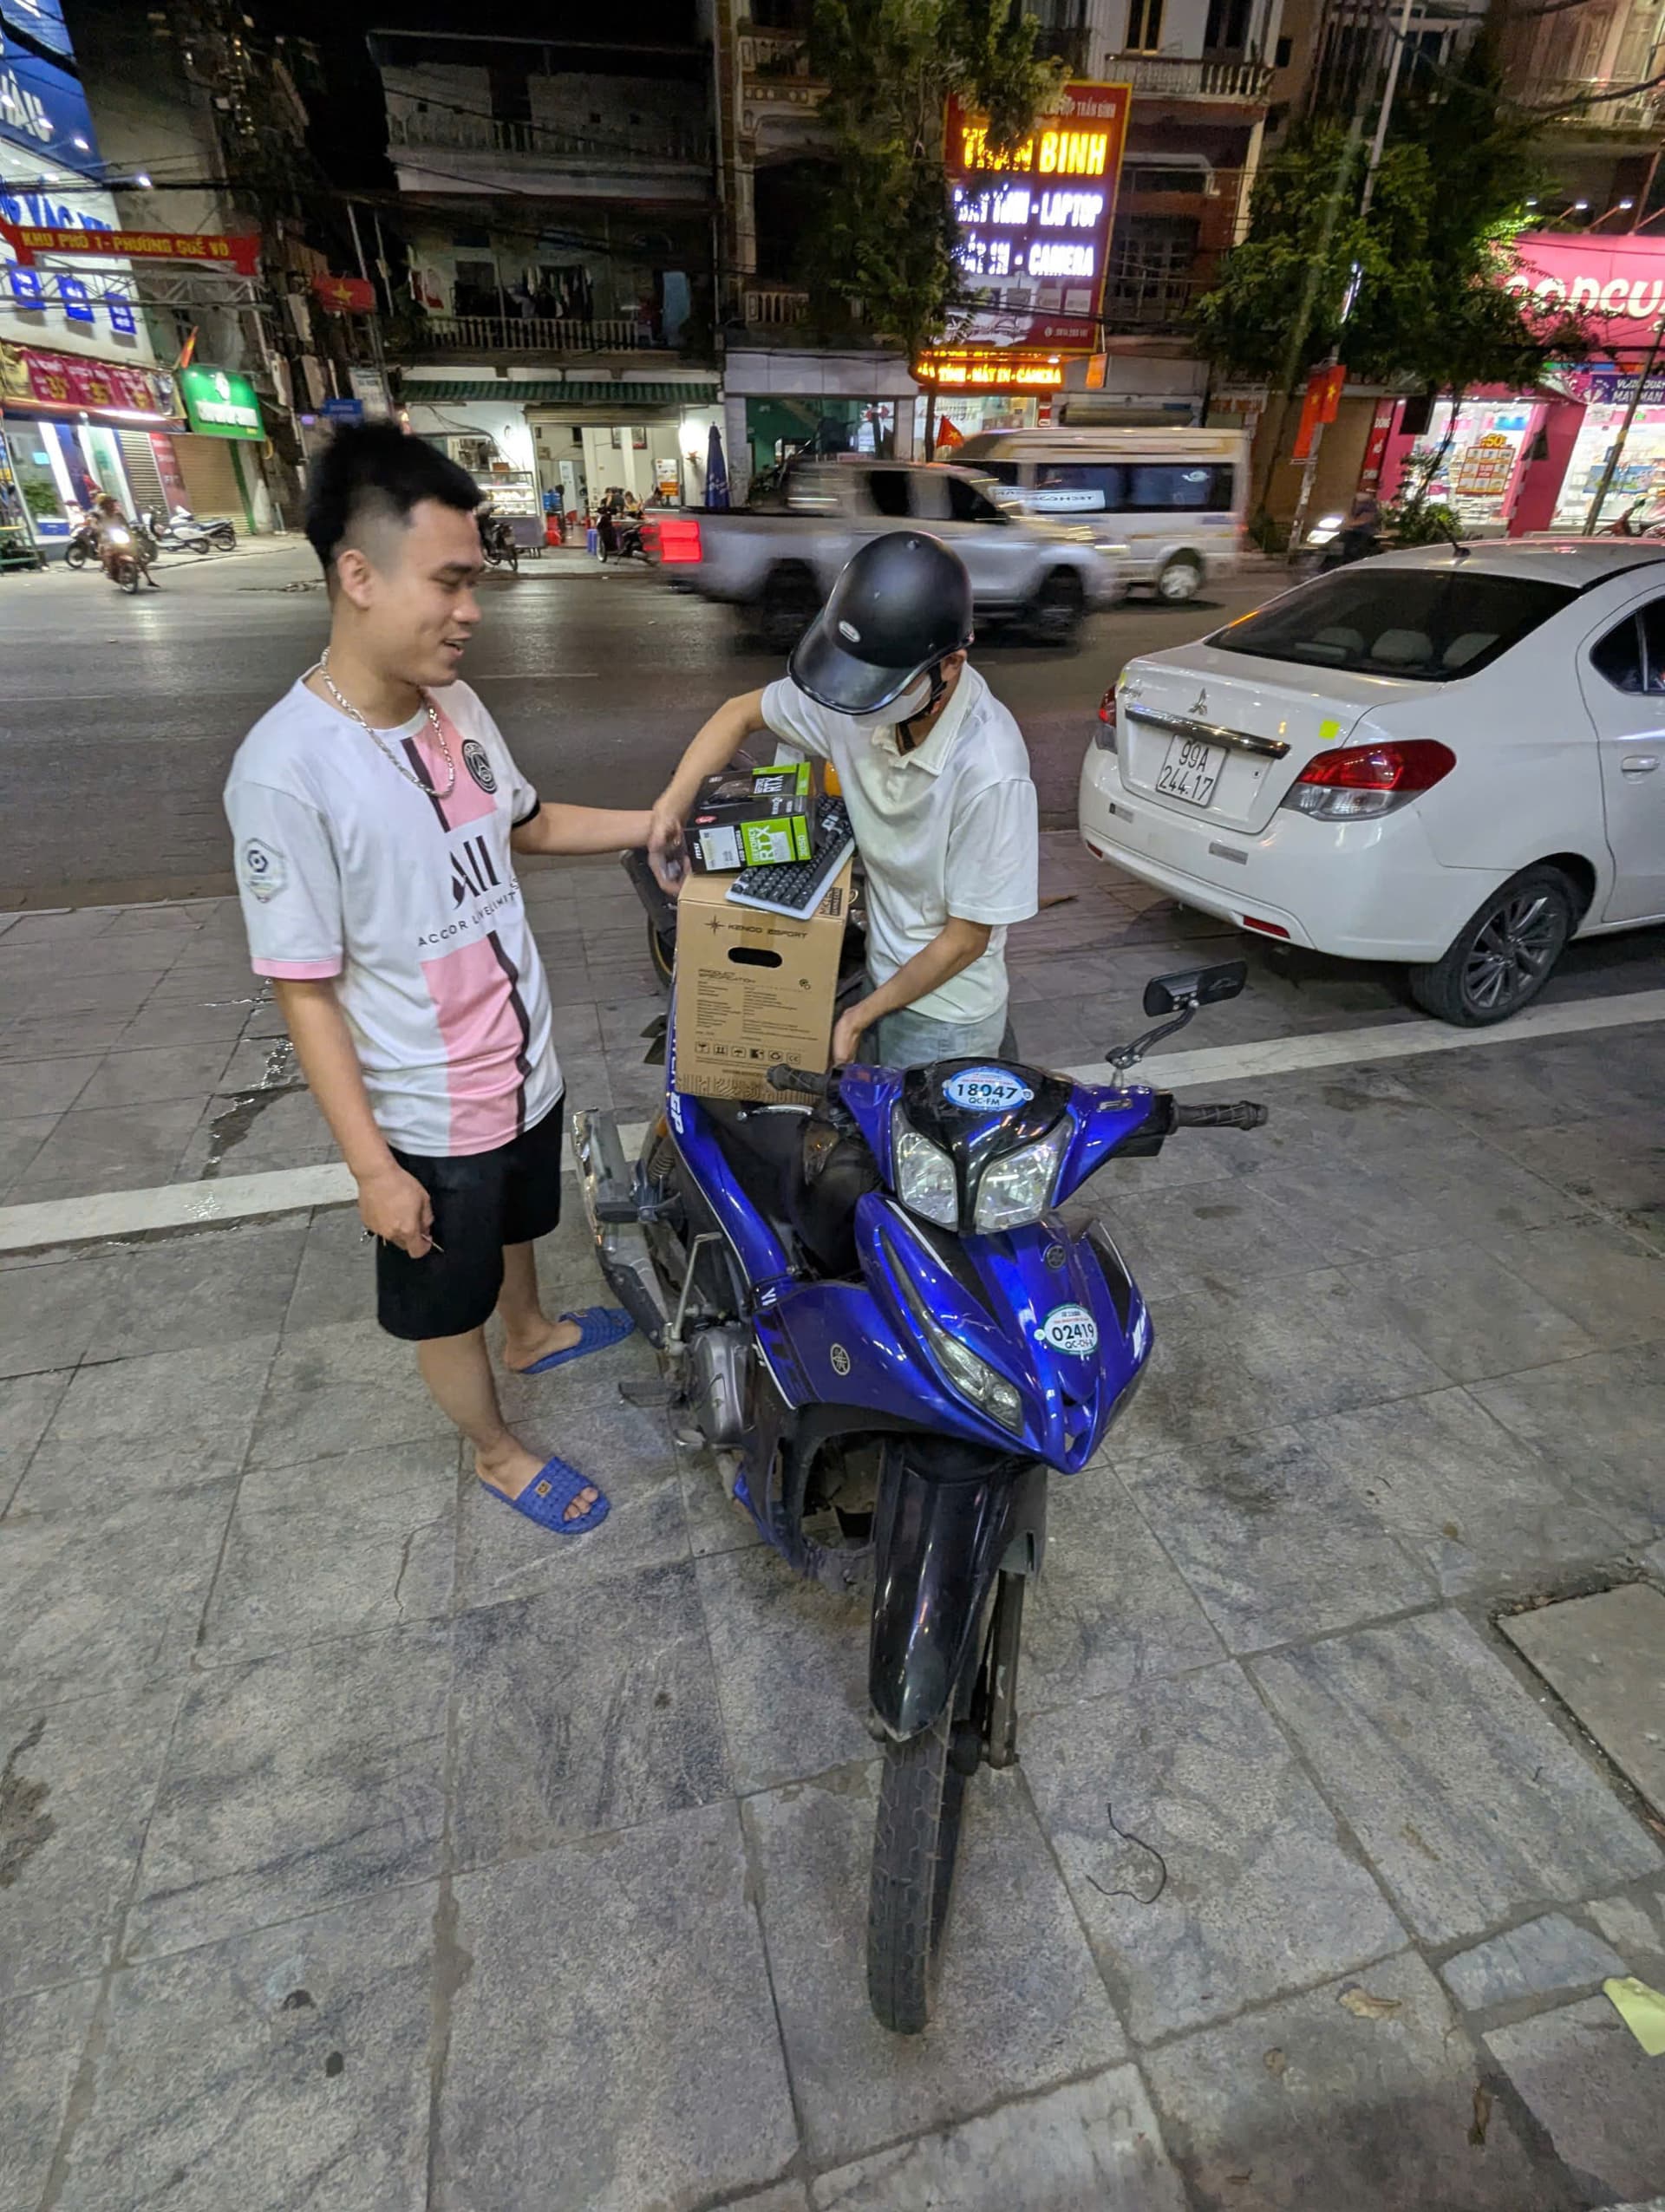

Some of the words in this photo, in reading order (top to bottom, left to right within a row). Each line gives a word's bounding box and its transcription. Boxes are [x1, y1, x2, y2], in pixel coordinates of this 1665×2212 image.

[1041, 191, 1103, 227] LAPTOP
[21, 232, 54, 247] KHU
[1028, 243, 1094, 277] CAMERA
[1016, 368, 1062, 384] CAMERA
[1179, 741, 1210, 773] 99A
[762, 775, 784, 793] RTX
[1159, 765, 1214, 801] 244.17
[757, 825, 775, 862] RTX
[418, 920, 469, 948] ACCOR
[767, 929, 808, 939] ESPORT
[957, 1083, 1018, 1099] 18047
[969, 1096, 1000, 1106] QC-FM
[1051, 1323, 1094, 1341] 02419
